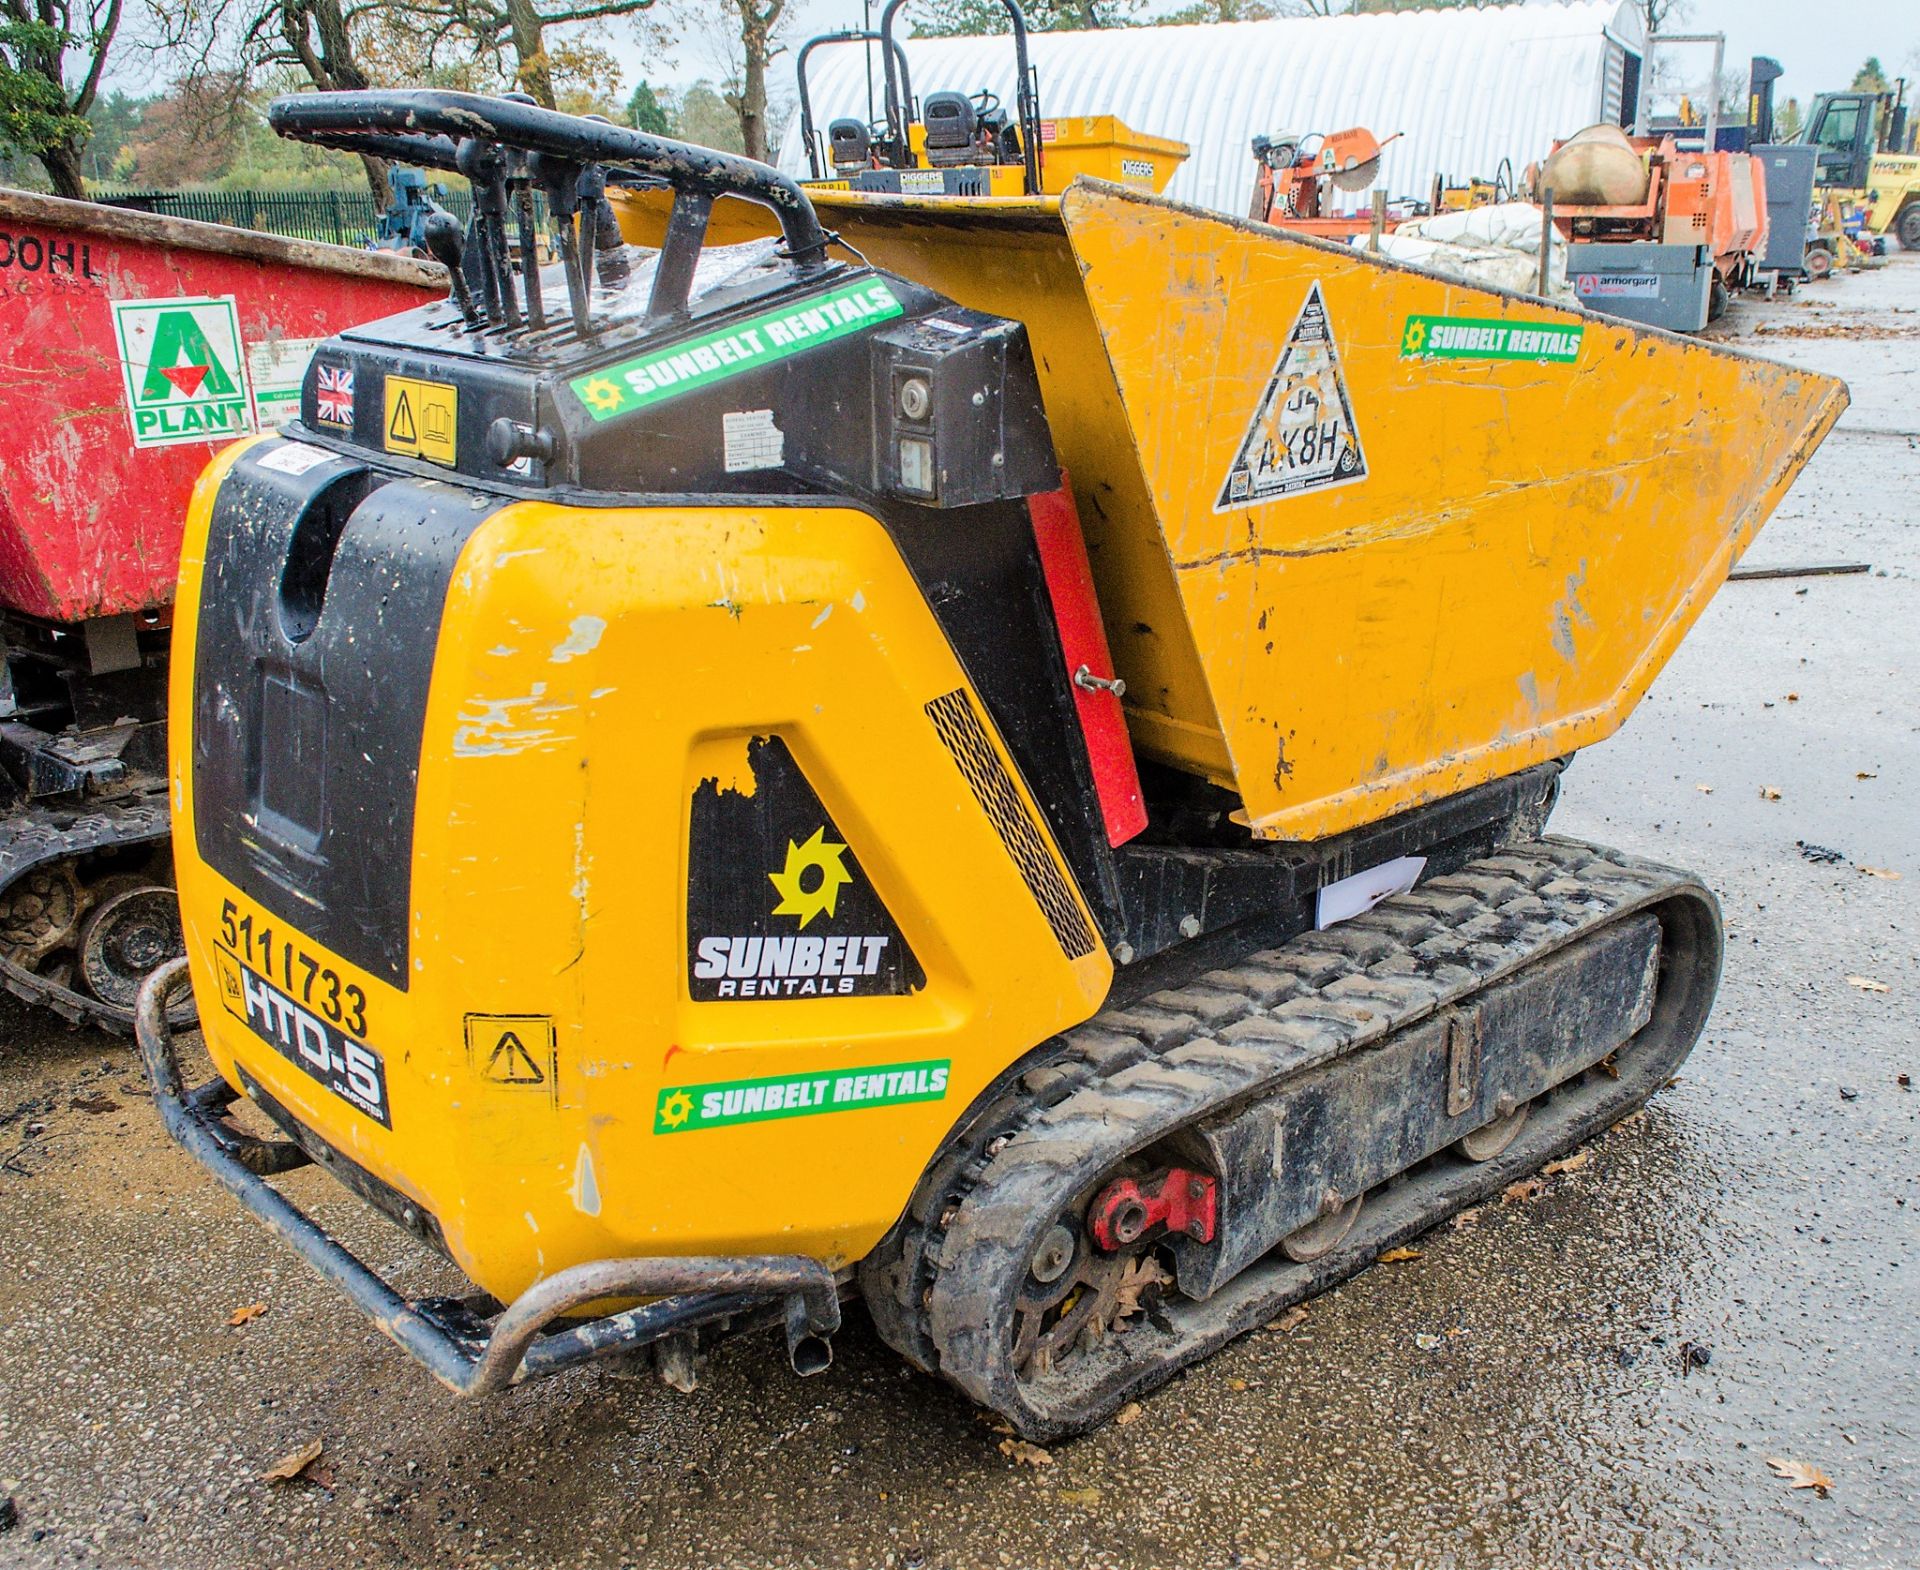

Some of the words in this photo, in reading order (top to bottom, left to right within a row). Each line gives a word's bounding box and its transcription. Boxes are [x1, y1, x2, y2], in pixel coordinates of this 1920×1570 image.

[901, 172, 943, 181] DIGGERS
[1122, 159, 1154, 177] DIGGERS
[1874, 162, 1917, 170] HYSTER
[1600, 276, 1657, 287] armorgard
[624, 329, 759, 395] SUNBELT
[763, 286, 895, 347] RENTALS
[1428, 325, 1506, 352] SUNBELT
[1507, 330, 1581, 356] RENTALS
[135, 402, 247, 435] PLANT
[221, 897, 367, 1039] 5111733
[694, 936, 888, 979] SUNBELT
[718, 978, 855, 997] RENTALS
[241, 967, 381, 1105] HTD-5
[333, 1079, 384, 1121] DUMPSTER
[700, 1079, 830, 1120] SUNBELT
[834, 1067, 948, 1102] RENTALS
